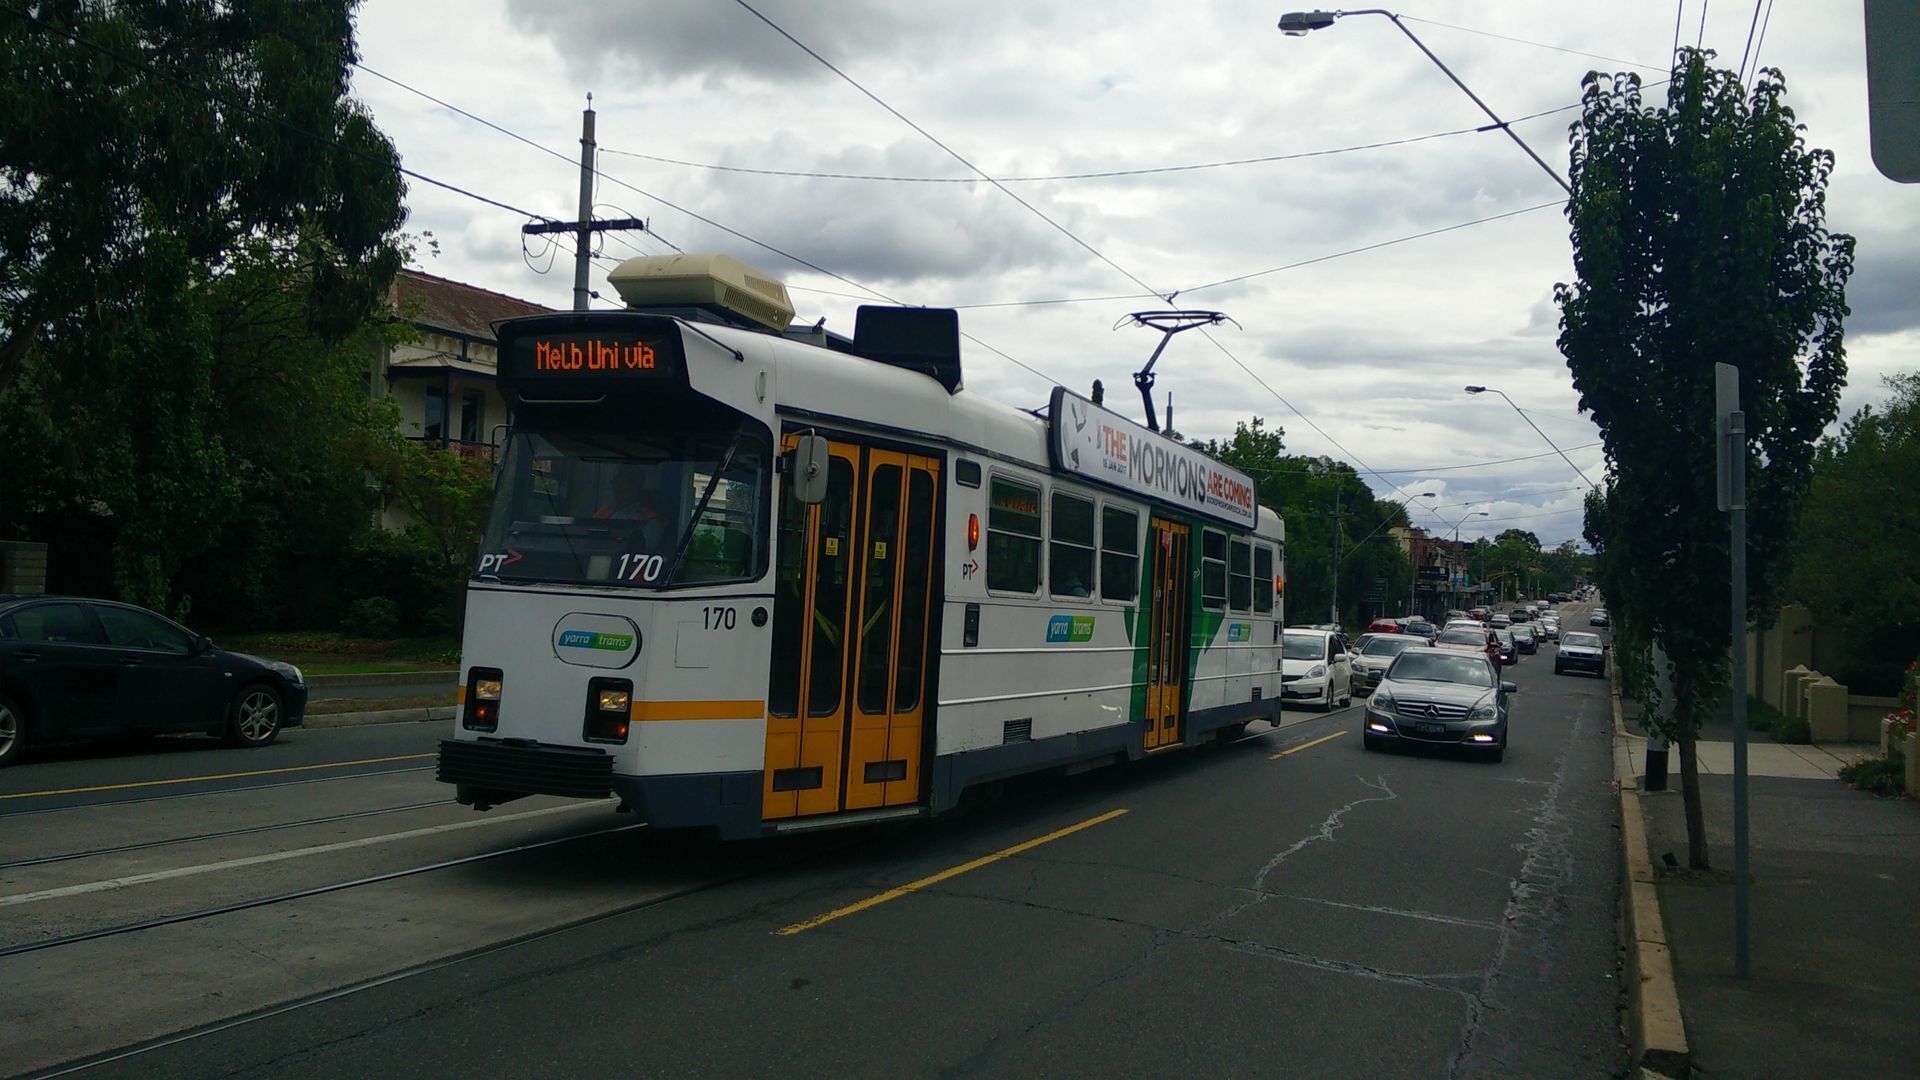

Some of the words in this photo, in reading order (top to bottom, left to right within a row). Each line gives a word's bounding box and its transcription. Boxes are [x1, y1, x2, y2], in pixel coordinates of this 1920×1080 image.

[536, 340, 583, 370] Melb
[588, 339, 618, 369] Uni
[624, 341, 655, 369] via
[1103, 424, 1127, 461] THE
[1129, 435, 1206, 505] MORMONS
[1207, 470, 1223, 498] ARE
[1224, 476, 1252, 510] COMING!
[478, 554, 507, 572] PT
[616, 553, 663, 581] 170
[962, 563, 973, 580] PT
[702, 606, 736, 630] 170
[1050, 620, 1068, 639] yarra
[1073, 618, 1092, 635] trams
[563, 633, 590, 645] yarra
[599, 635, 627, 647] trams
